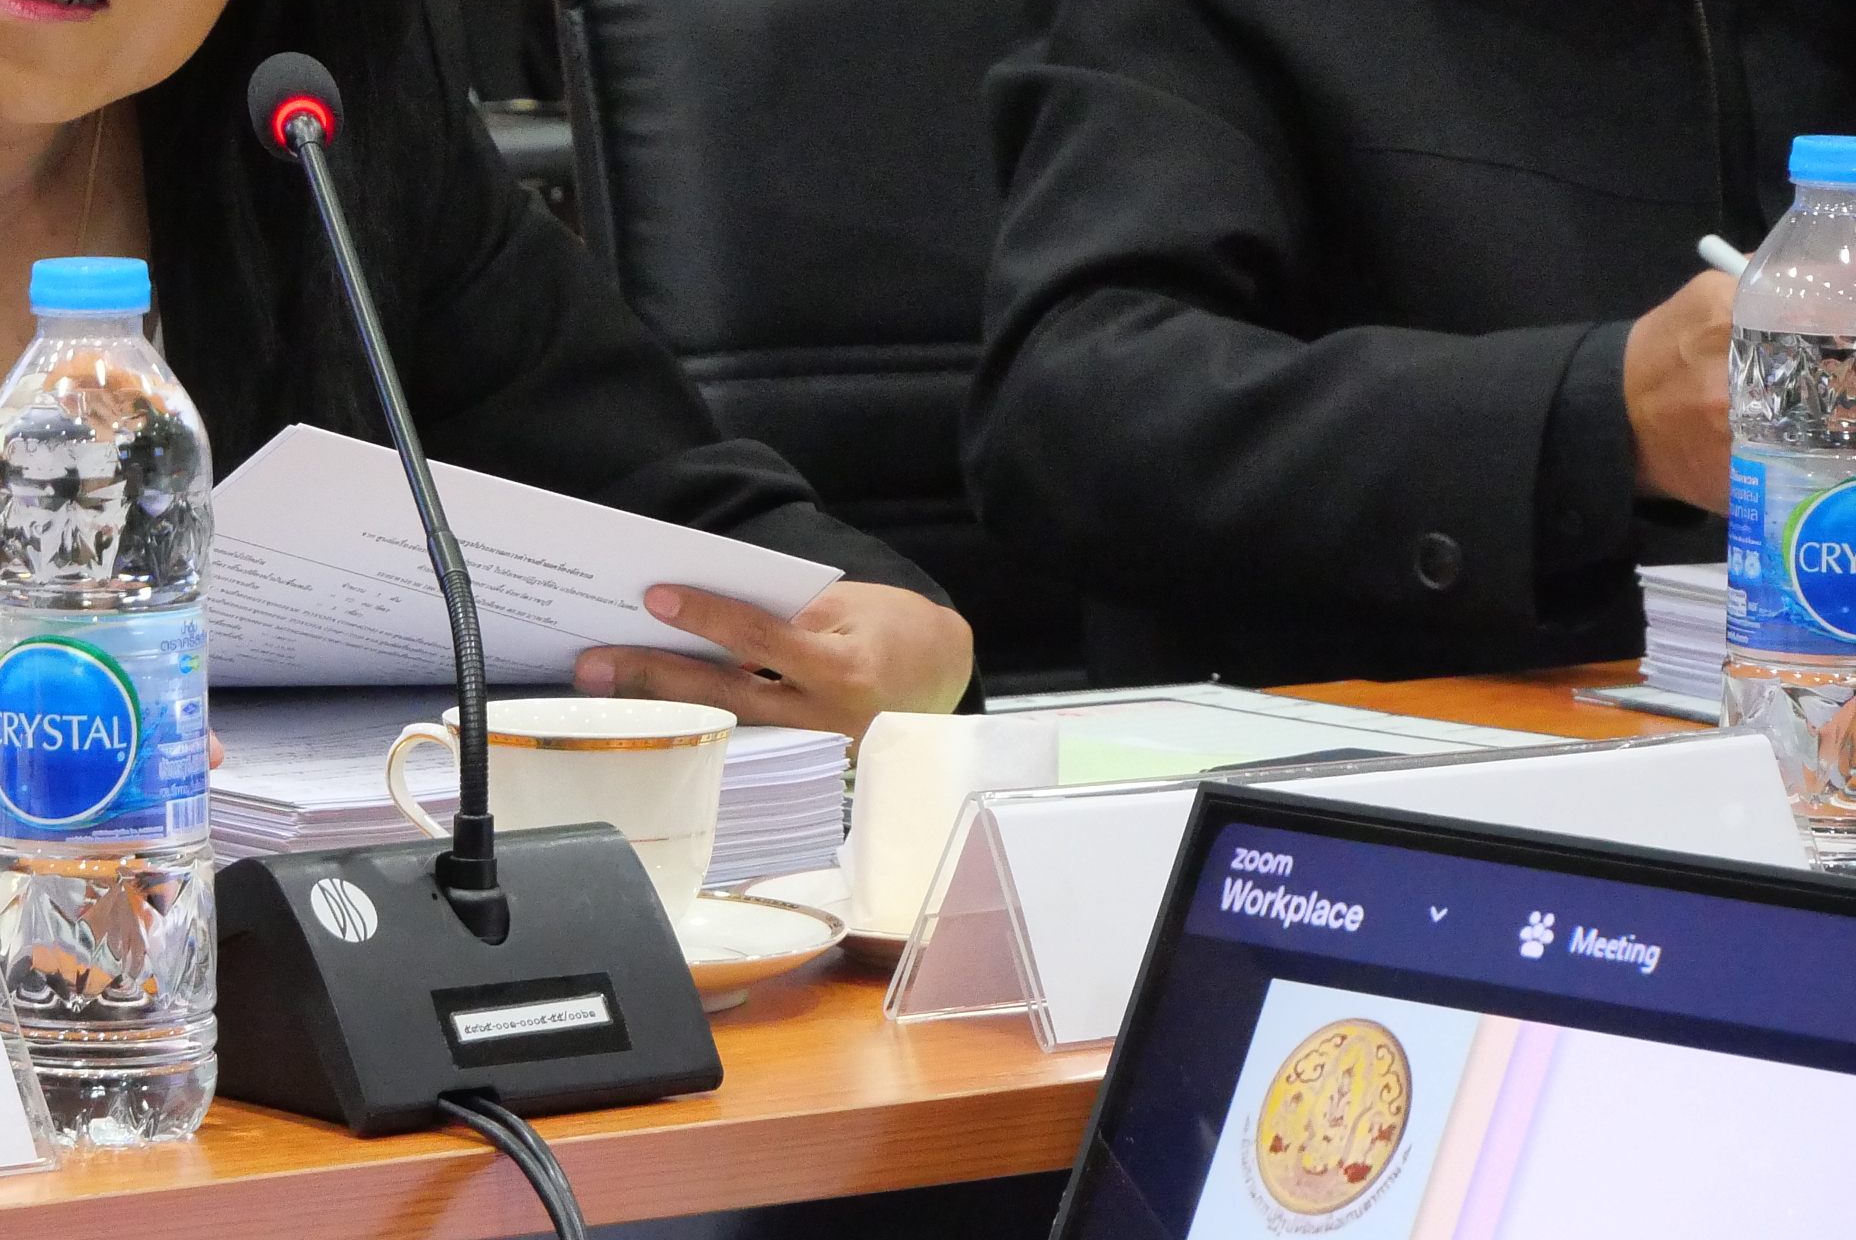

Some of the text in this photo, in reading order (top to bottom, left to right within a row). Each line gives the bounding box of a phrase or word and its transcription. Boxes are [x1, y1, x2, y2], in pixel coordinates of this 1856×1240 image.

[1230, 847, 1294, 877] zoom
[1220, 876, 1365, 932] Workplace
[1569, 925, 1662, 975] Meeting
